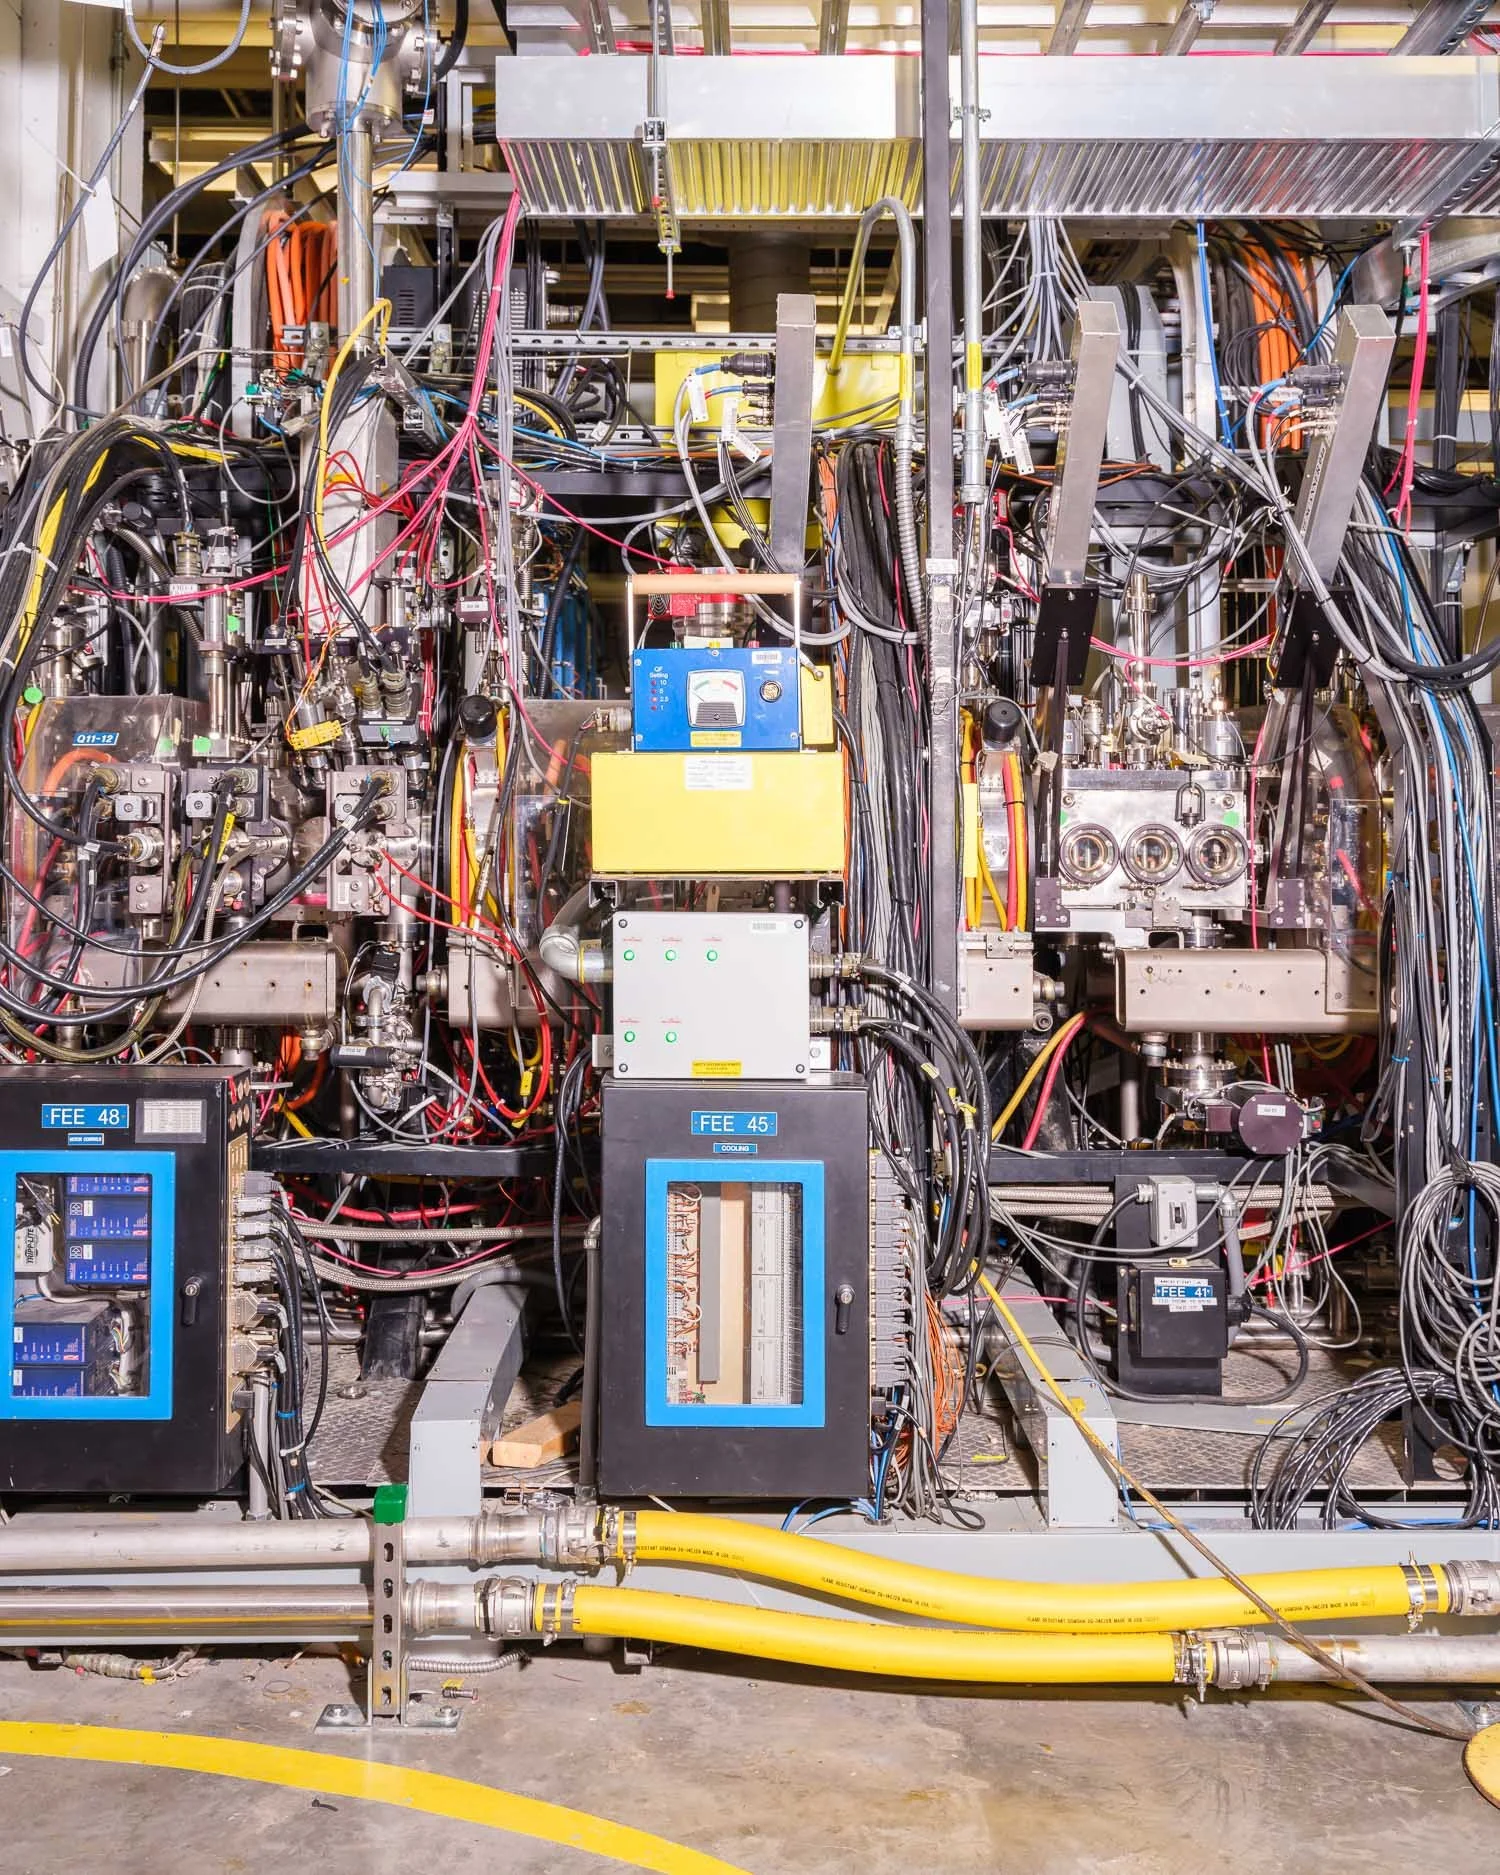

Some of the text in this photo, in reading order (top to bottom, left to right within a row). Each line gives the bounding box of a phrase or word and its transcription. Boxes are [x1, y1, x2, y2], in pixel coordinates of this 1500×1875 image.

[76, 734, 114, 744] Q11-12
[50, 1108, 120, 1125] FEE 48
[700, 1115, 769, 1133] FEE 45
[721, 1144, 750, 1152] COOLING
[1161, 1286, 1207, 1297] FEE 41
